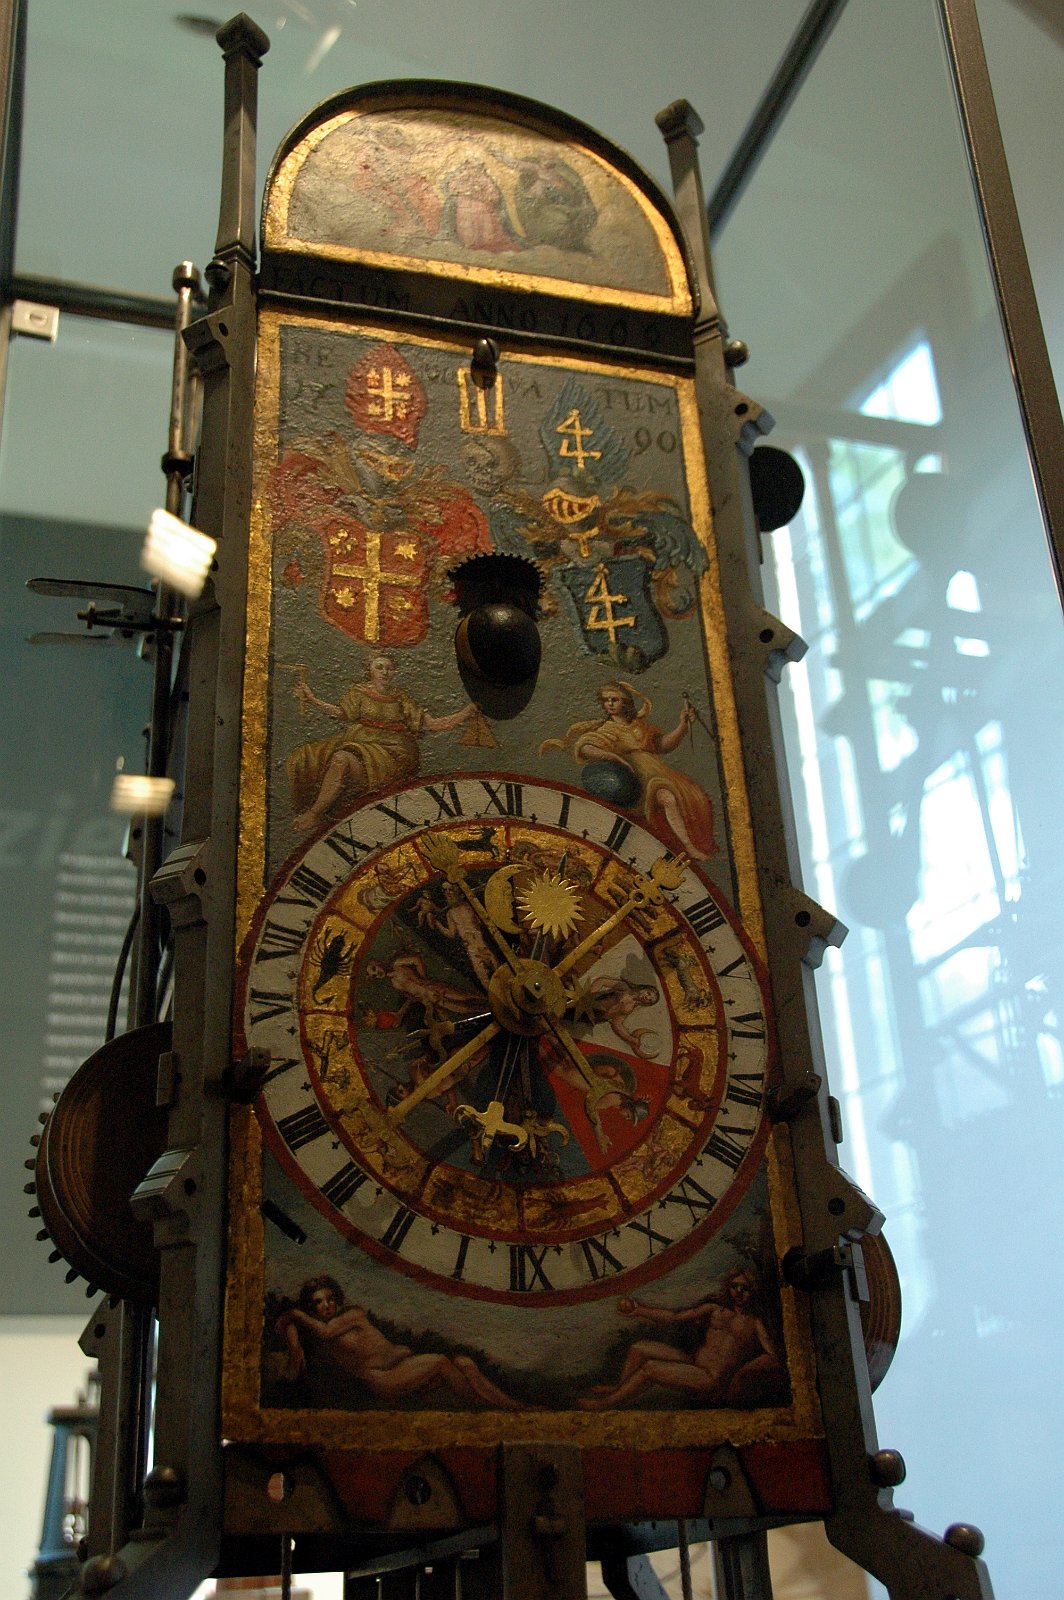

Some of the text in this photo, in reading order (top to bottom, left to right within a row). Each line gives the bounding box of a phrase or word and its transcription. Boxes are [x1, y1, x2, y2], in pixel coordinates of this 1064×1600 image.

[450, 296, 537, 330] ANNO
[634, 426, 677, 457] 90
[369, 792, 423, 838] X
[424, 782, 463, 821] XI
[479, 781, 524, 818] XII
[323, 819, 377, 867] IX
[603, 814, 635, 854] II
[274, 862, 334, 909] VIII
[255, 920, 309, 964] VII
[716, 953, 752, 981] V
[250, 988, 293, 1025] VI
[730, 1011, 766, 1044] VI
[725, 1073, 766, 1111] VII
[276, 1100, 332, 1156] IIII
[700, 1125, 757, 1174] VIII
[319, 1160, 372, 1211] III
[664, 1175, 719, 1226] IX
[378, 1201, 423, 1252] II
[626, 1210, 676, 1258] X
